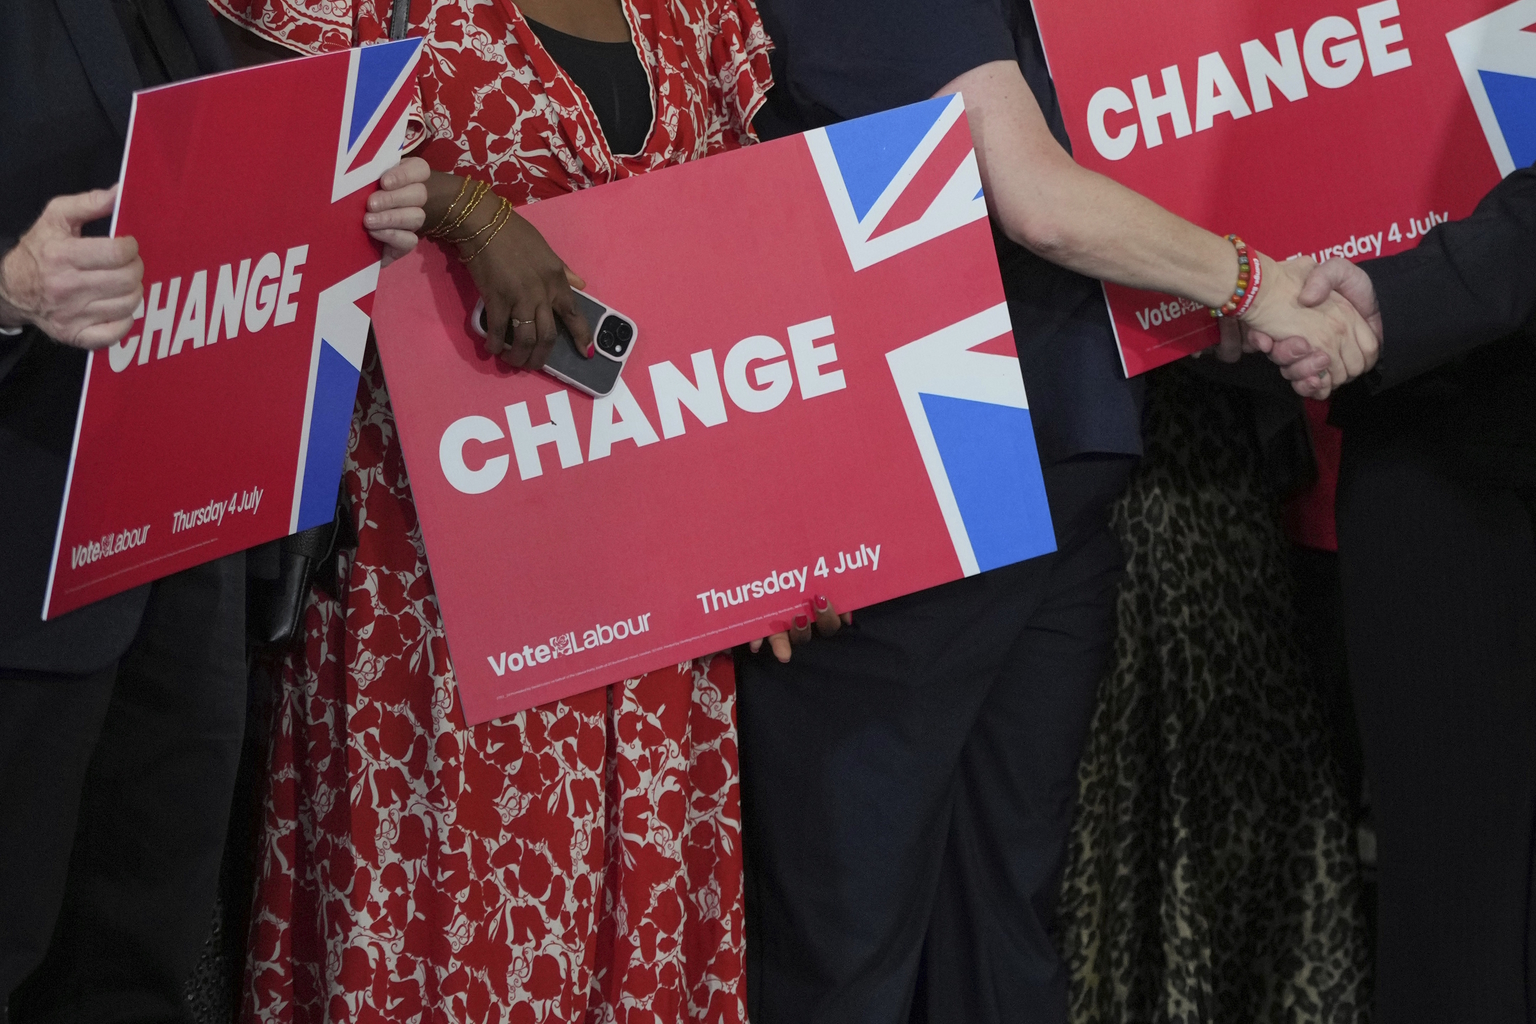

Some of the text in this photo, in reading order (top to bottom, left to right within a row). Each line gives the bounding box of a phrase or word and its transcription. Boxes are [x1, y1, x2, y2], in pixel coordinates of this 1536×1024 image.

[1286, 231, 1383, 265] ursday
[1387, 222, 1402, 244] 4
[108, 244, 310, 373] CHANGE
[1135, 301, 1181, 330] Vote
[438, 314, 847, 495] CHANGE
[172, 486, 264, 534] Thursday 4 July
[71, 537, 102, 571] Vote
[107, 524, 151, 557] Labour
[696, 543, 881, 614] Thursday 4 July
[486, 611, 651, 677] Vote Labour
